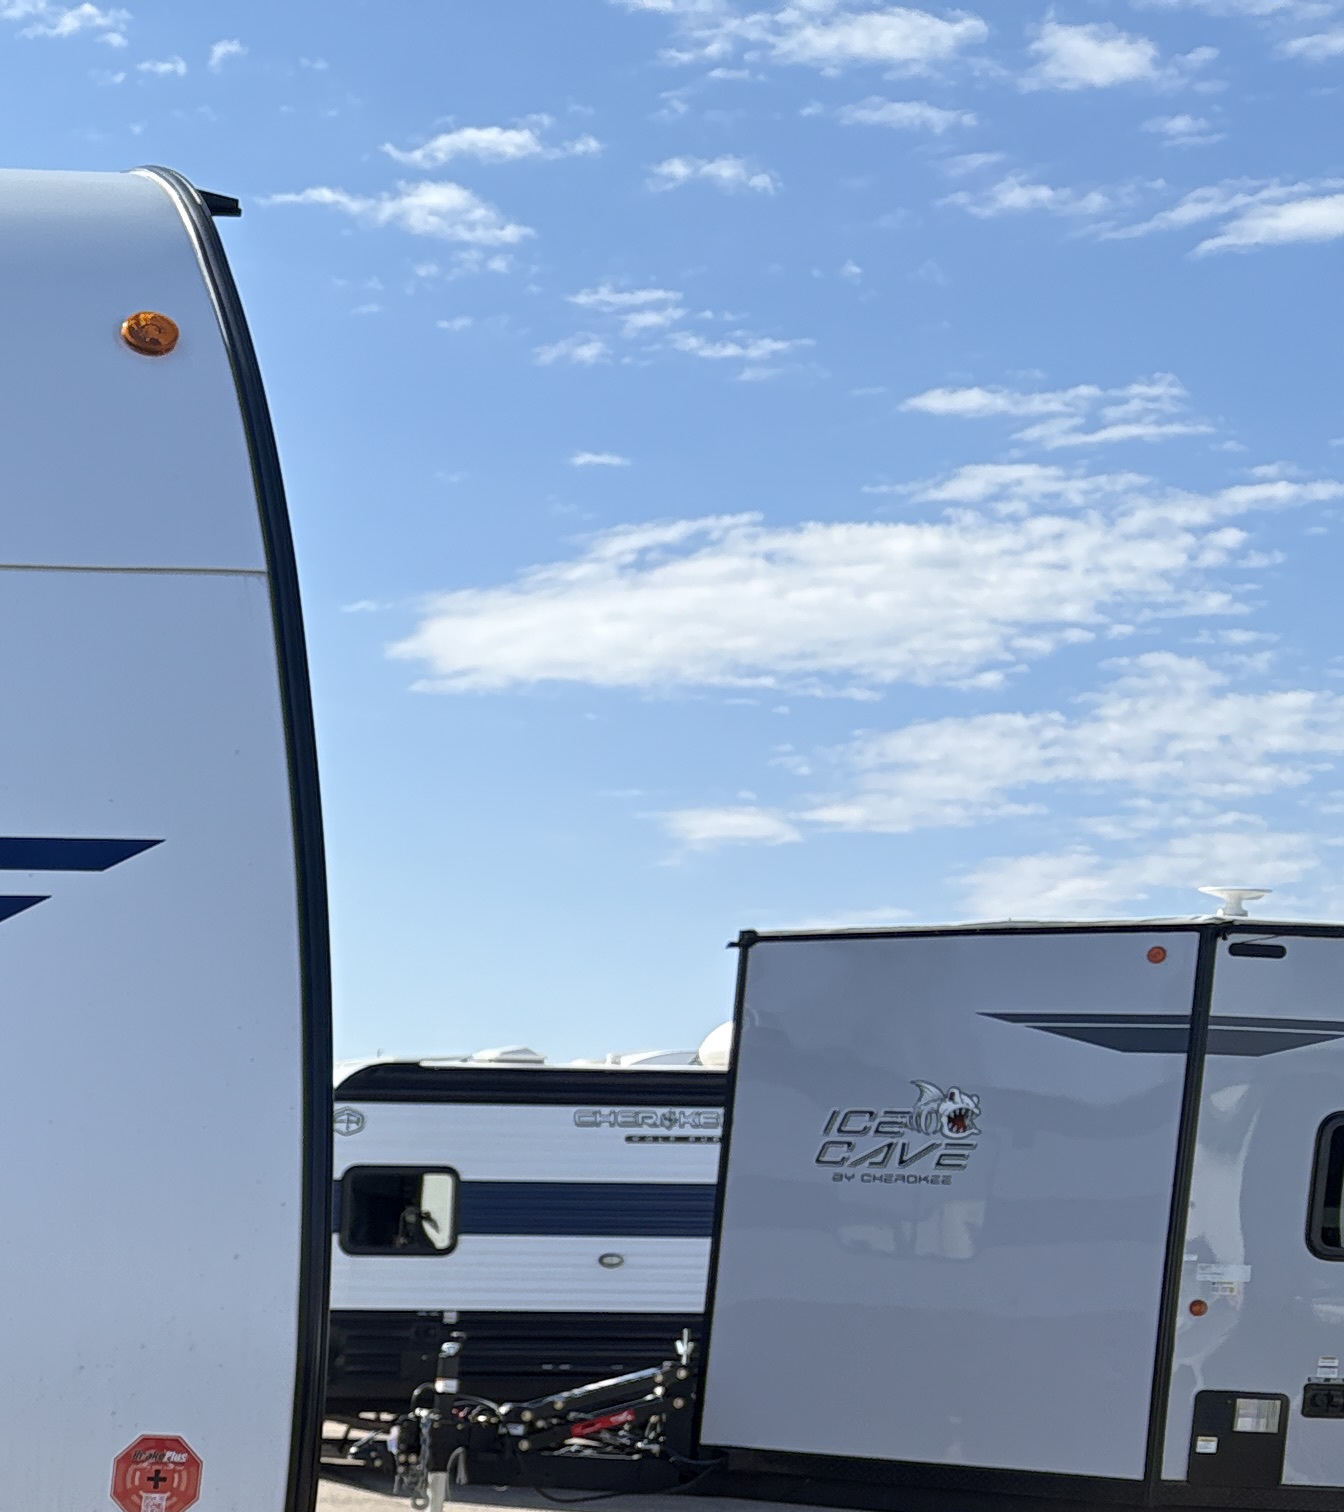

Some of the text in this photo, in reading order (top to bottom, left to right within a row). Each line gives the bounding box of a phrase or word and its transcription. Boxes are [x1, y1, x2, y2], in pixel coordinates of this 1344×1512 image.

[573, 1108, 723, 1131] CHEROKE
[822, 1107, 914, 1138] ICE
[814, 1138, 978, 1171] CAVE
[832, 1172, 953, 1186] BY CHEROKEE
